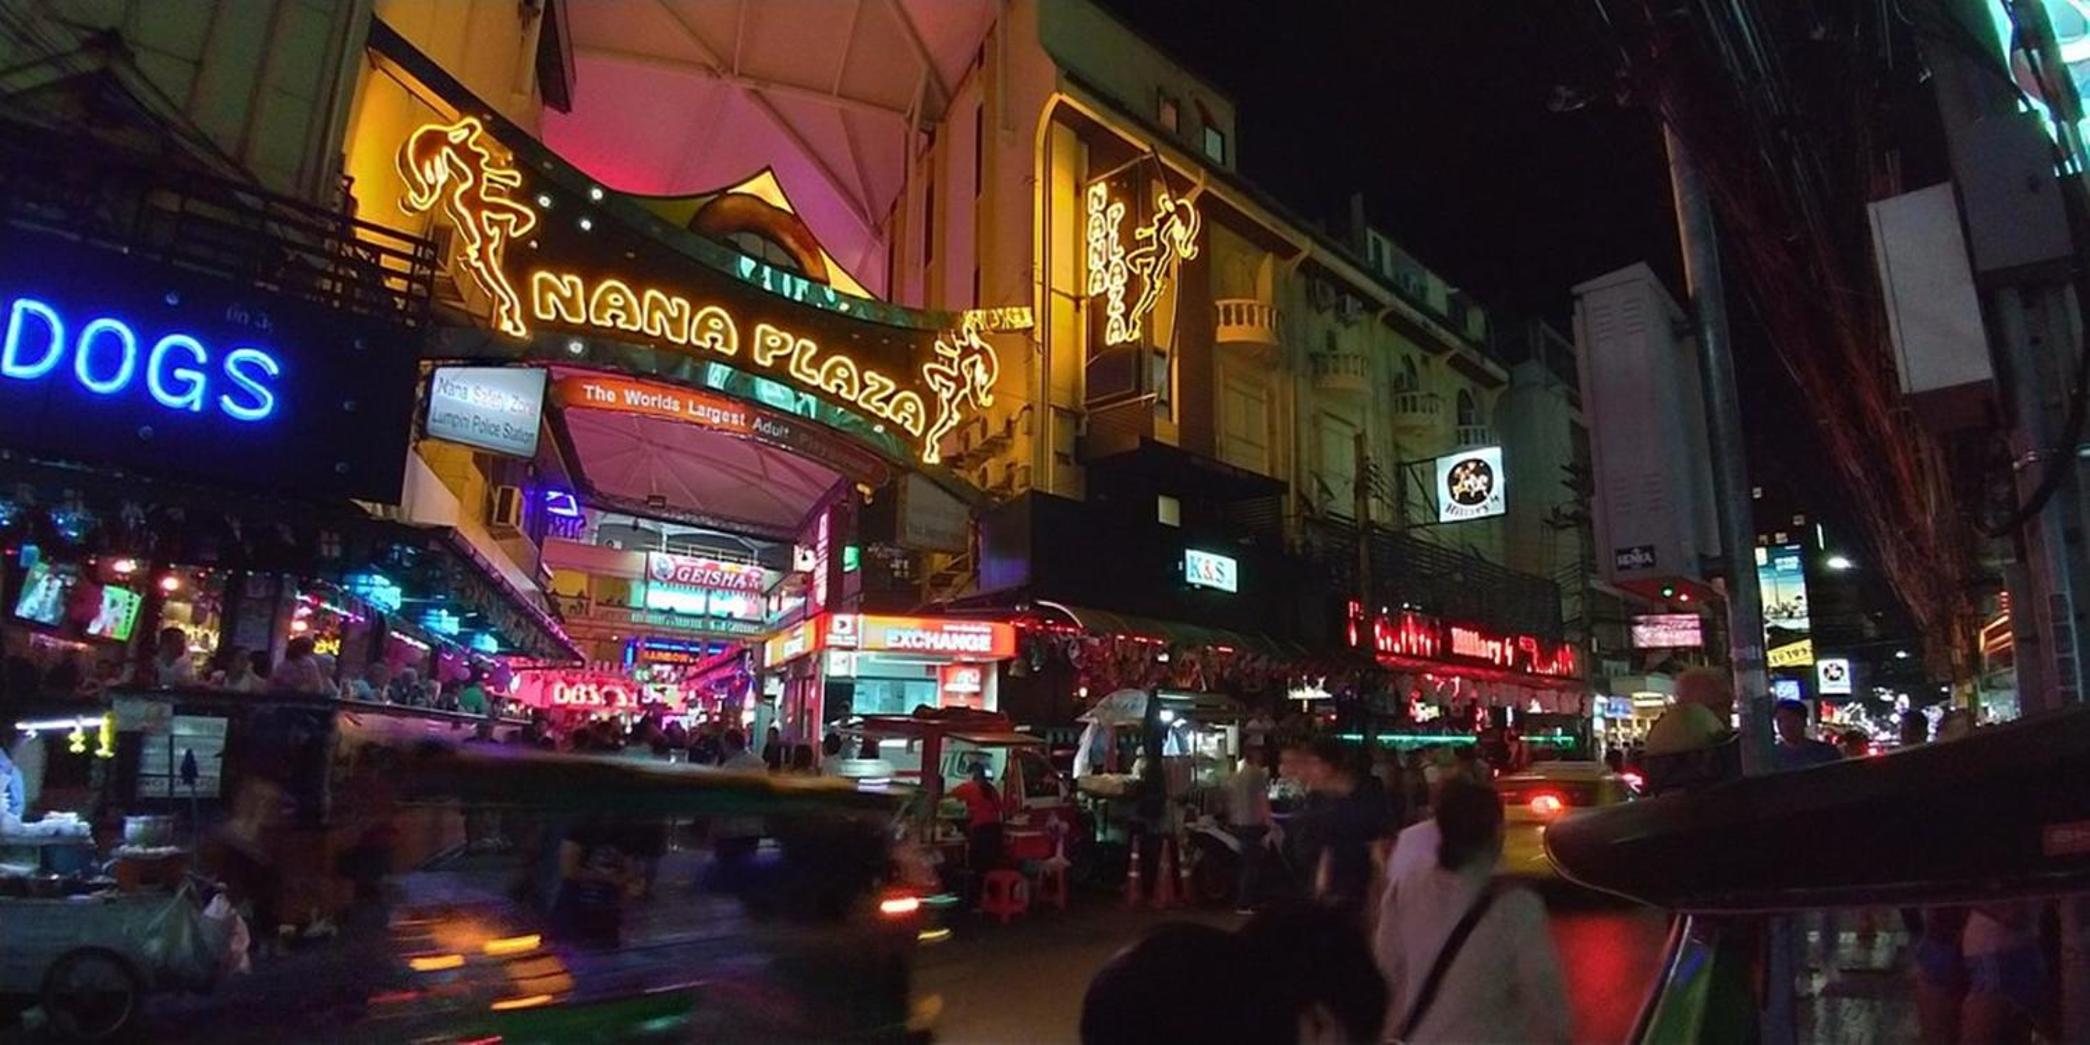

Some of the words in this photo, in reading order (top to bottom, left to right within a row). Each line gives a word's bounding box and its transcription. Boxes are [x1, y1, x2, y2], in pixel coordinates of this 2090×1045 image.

[1087, 182, 1107, 297] NANA
[1106, 202, 1128, 345] PLAZA
[1, 298, 280, 421] DOGS
[532, 271, 739, 356] NANA
[754, 323, 926, 438] PLAZA
[583, 384, 616, 403] The
[624, 389, 681, 412] Worlds
[688, 401, 746, 427] Largest
[752, 416, 790, 438] Adult
[676, 566, 748, 588] GEISHA
[1189, 555, 1225, 584] K&S
[885, 628, 993, 652] EXCHANGE
